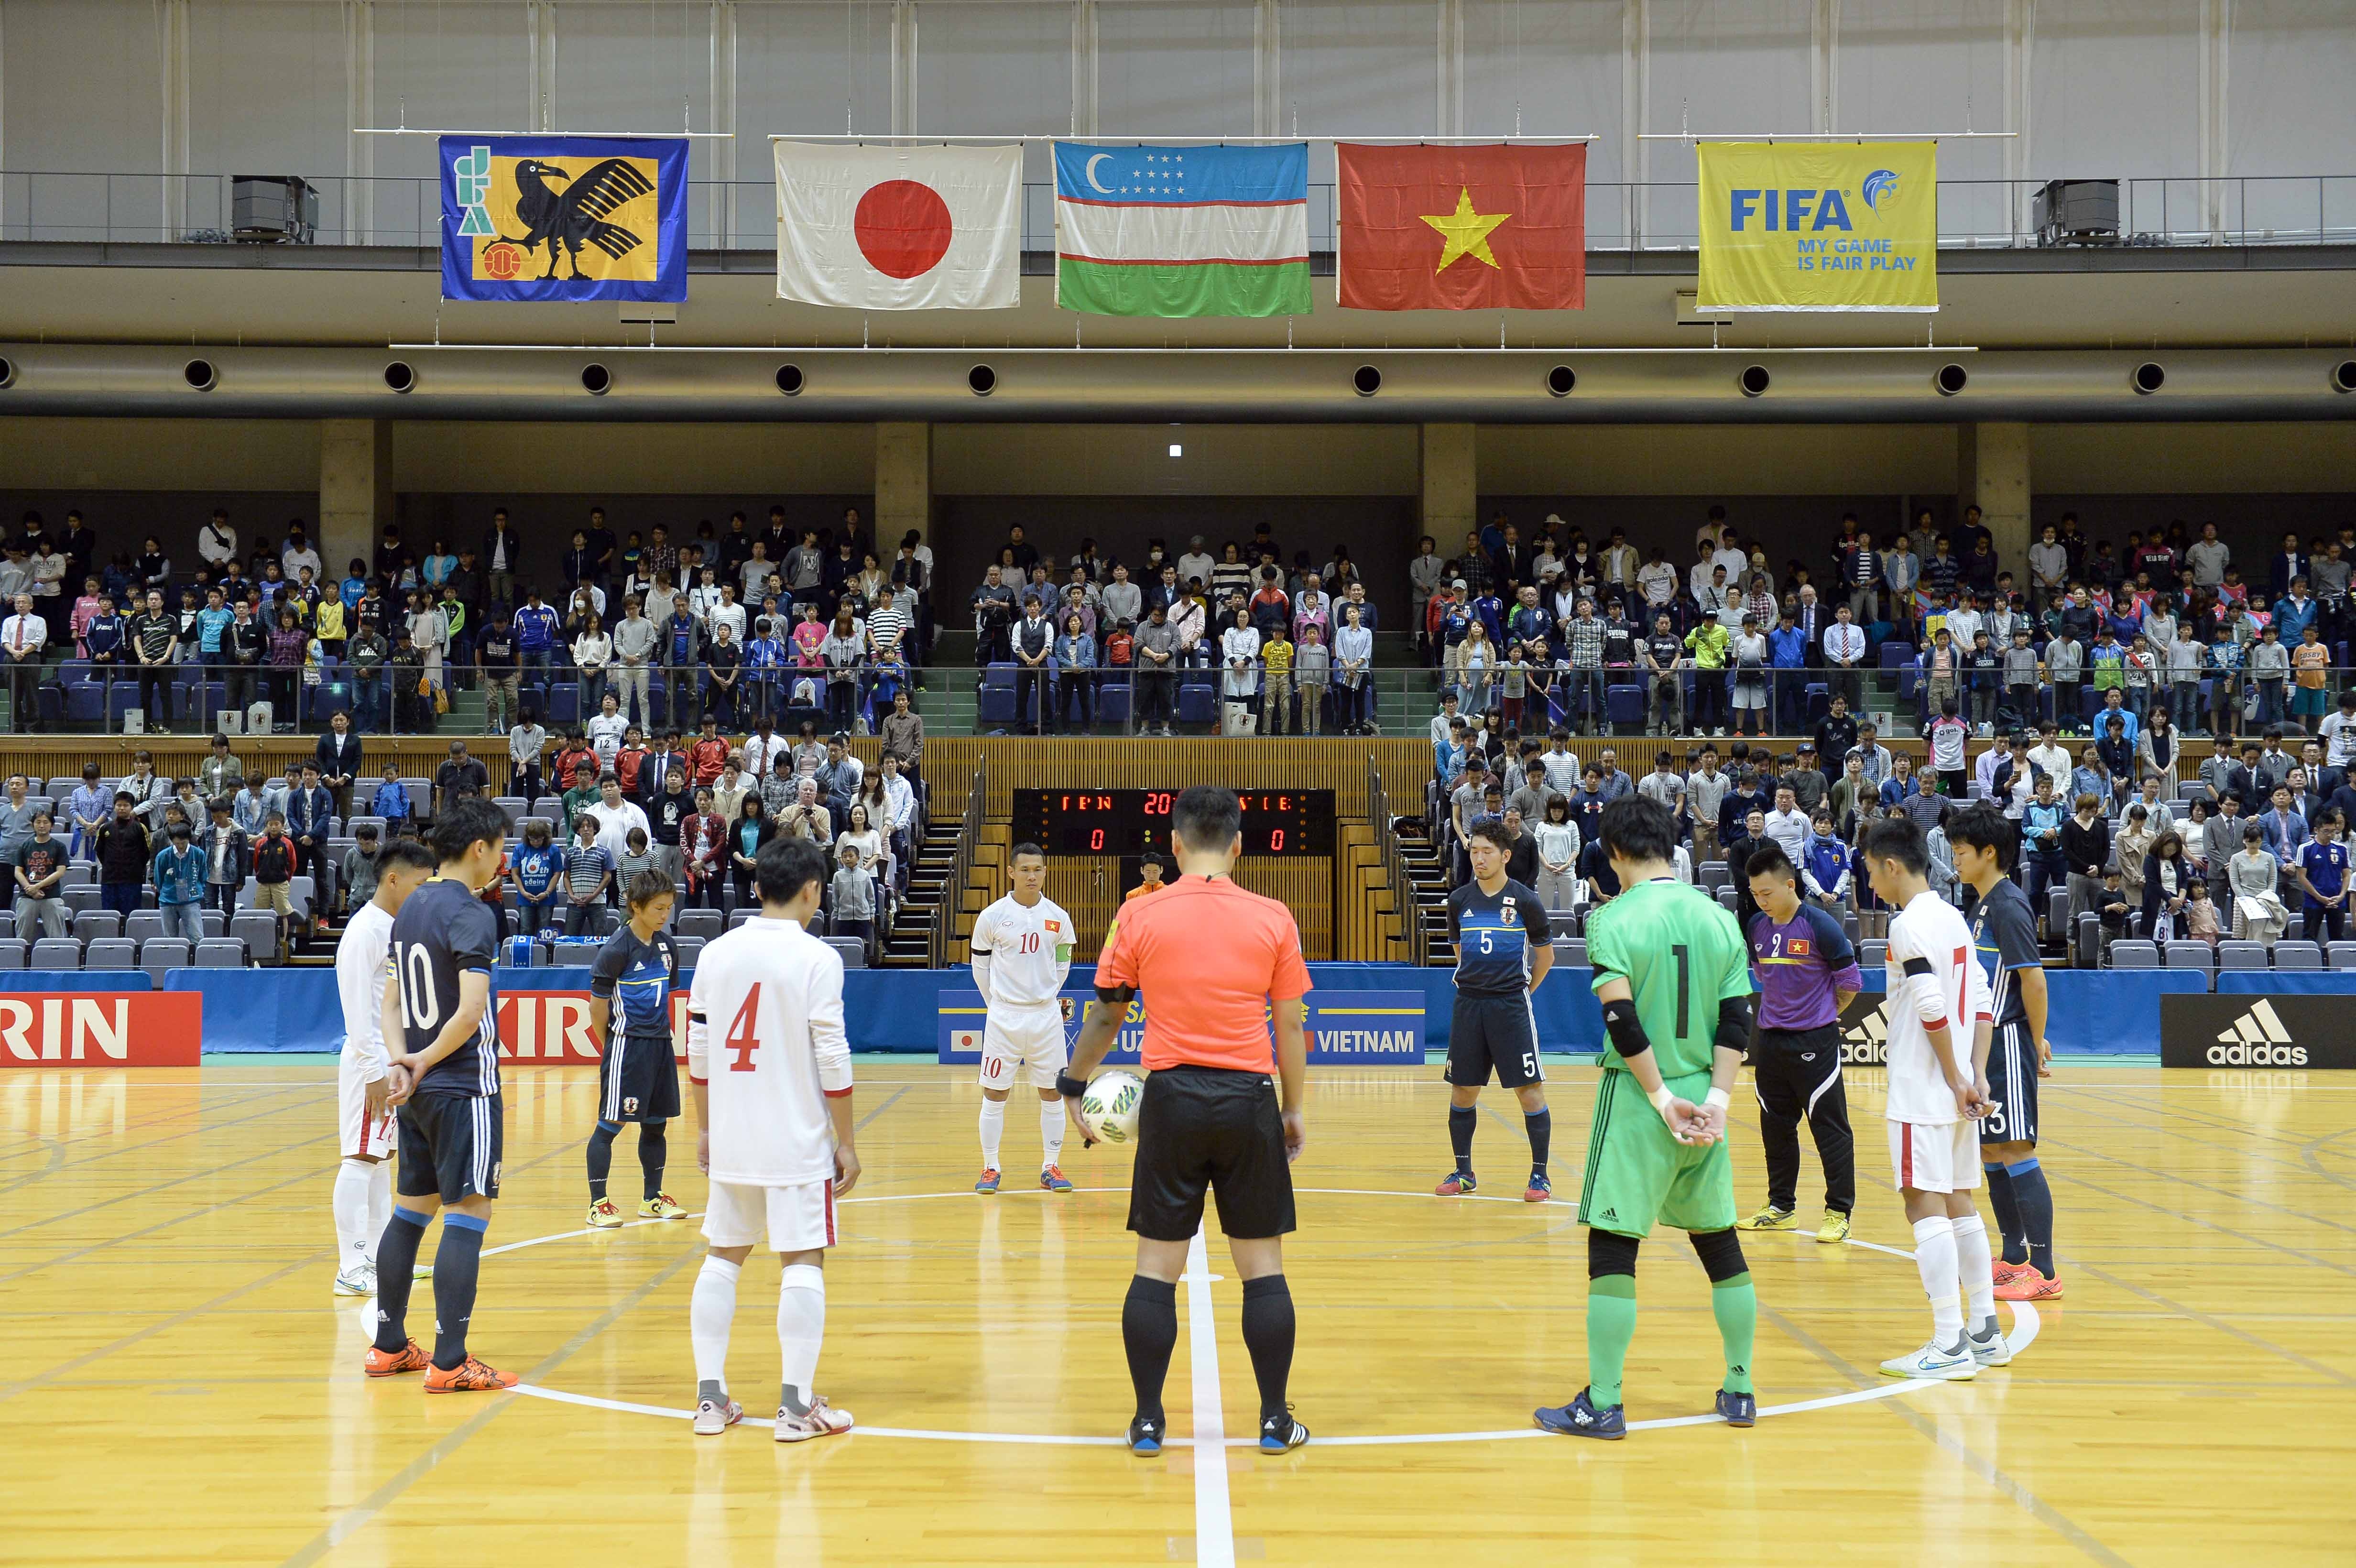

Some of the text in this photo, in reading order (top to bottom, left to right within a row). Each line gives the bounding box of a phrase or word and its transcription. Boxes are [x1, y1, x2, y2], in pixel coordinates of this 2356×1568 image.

[1798, 240, 1892, 253] MY GAME
[1798, 257, 1916, 271] IS FAIR PLAY
[1091, 829, 1104, 850] 0
[1271, 830, 1284, 850] 0
[1019, 932, 1040, 954] 10
[1480, 930, 1493, 954] 5
[1772, 933, 1781, 958] 2
[394, 941, 439, 1030] 10
[650, 981, 663, 1007] 7
[1672, 945, 1689, 1039] 1
[1952, 945, 1967, 1027] 7
[725, 982, 761, 1072] 4
[1317, 1031, 1414, 1052] VIETNAM
[2207, 1041, 2308, 1066] adidas
[983, 1056, 1002, 1079] 10
[1523, 1052, 1536, 1078] 5
